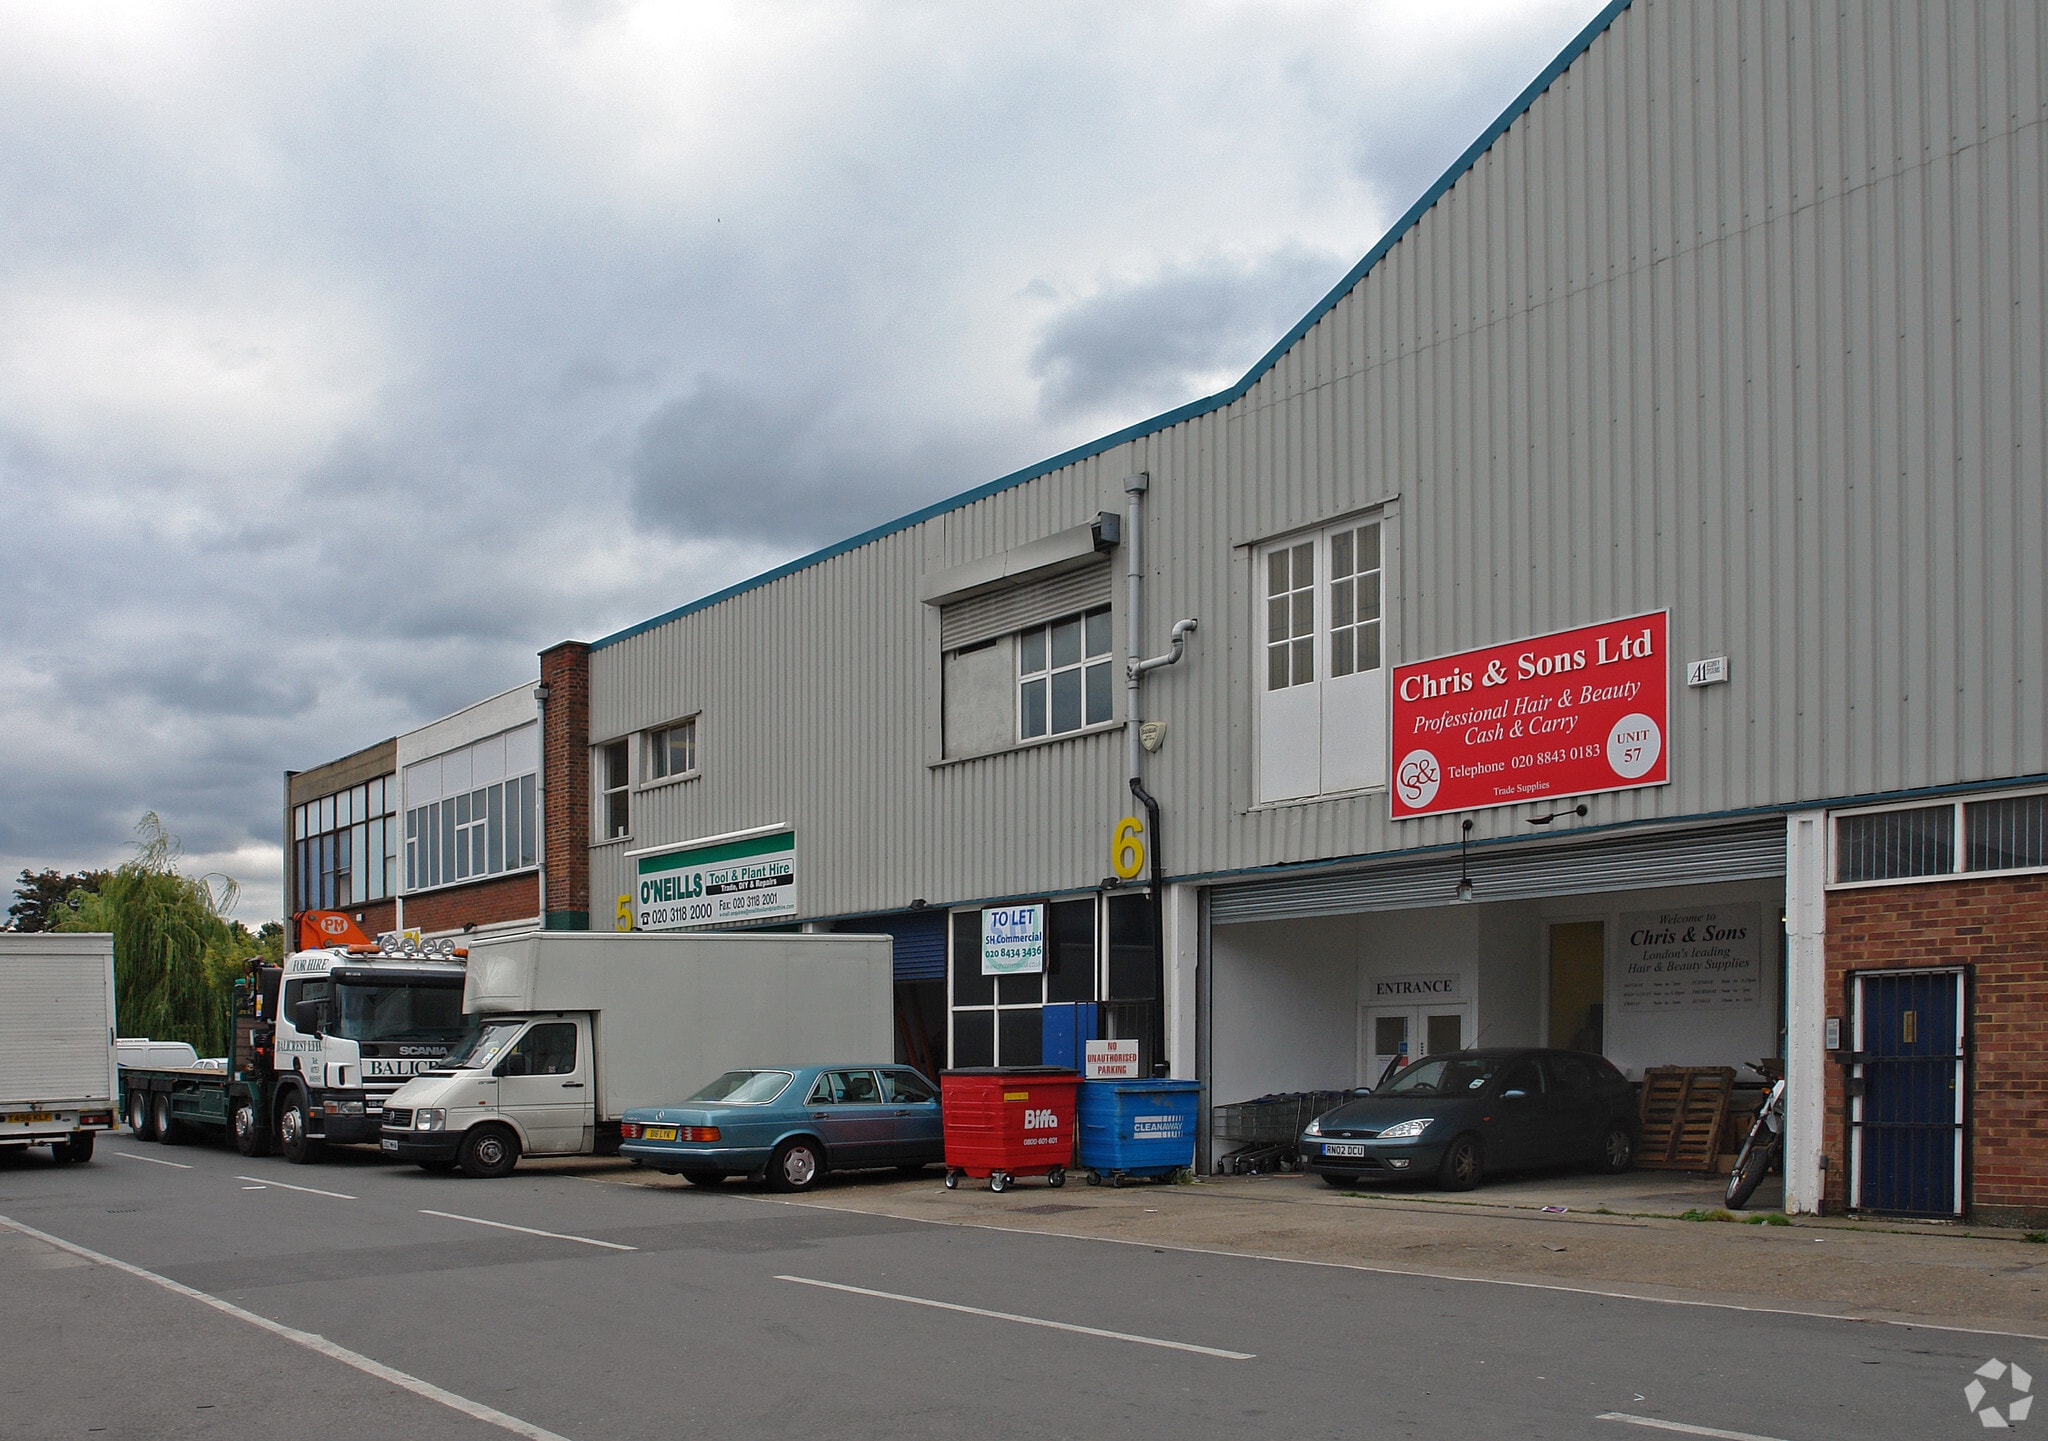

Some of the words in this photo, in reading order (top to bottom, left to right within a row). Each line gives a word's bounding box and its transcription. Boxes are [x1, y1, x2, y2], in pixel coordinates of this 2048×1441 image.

[1400, 668, 1473, 702] Chris
[1482, 660, 1508, 687] &
[1517, 647, 1586, 681] Sons
[1596, 629, 1653, 666] Ltd
[1413, 700, 1508, 734] Professional
[1514, 696, 1552, 716] Hair
[1557, 689, 1573, 707] &
[1578, 680, 1641, 704] Beauty
[1465, 724, 1504, 745] Cash
[1509, 719, 1524, 738] &
[1529, 715, 1578, 735] Carry
[1616, 729, 1650, 744] UNIT
[1448, 760, 1505, 779] Telephone
[1511, 755, 1533, 769] 020
[1537, 750, 1566, 765] 8843
[1570, 743, 1600, 760] 0183
[1624, 747, 1642, 763] 57
[1493, 786, 1516, 796] Trade
[1517, 781, 1550, 794] Supplies
[1112, 816, 1144, 879] 6
[641, 873, 702, 904] O'NEILLS
[709, 870, 728, 884] Tool
[732, 868, 739, 881] &
[742, 864, 766, 879] Plant
[769, 862, 790, 876] Hire
[721, 883, 739, 892] Trade,
[740, 881, 749, 891] DIY
[750, 880, 755, 889] &
[756, 877, 778, 888] Repairs
[719, 900, 731, 911] Fax:
[732, 897, 745, 909] 020
[747, 895, 760, 907] 3118
[762, 893, 778, 905] 2001
[615, 894, 633, 931] 5
[652, 909, 667, 924] 020
[670, 906, 687, 921] 3118
[690, 903, 712, 919] 2000
[991, 911, 1008, 927] TO
[1012, 909, 1035, 925] LET
[1660, 912, 1703, 924] Welcome
[1706, 913, 1716, 921] to
[325, 918, 346, 932] PM
[985, 935, 996, 945] SH
[996, 931, 1042, 944] Commercial
[1630, 929, 1676, 946] Chris
[1682, 926, 1697, 942] &
[1703, 925, 1747, 941] Sons
[985, 950, 999, 958] 020
[1000, 948, 1020, 958] 8434
[1022, 946, 1042, 958] 3436
[1643, 948, 1688, 960] London's
[1692, 946, 1730, 958] leading
[293, 960, 306, 971] FOR
[307, 959, 329, 970] HIRE
[1628, 963, 1651, 974] Hair
[1654, 961, 1662, 972] &
[1667, 960, 1703, 973] Beauty
[1705, 957, 1750, 971] Supplies
[1377, 980, 1452, 994] ENTRANCE
[399, 1046, 448, 1055] SCANIA
[1108, 1042, 1117, 1050] NO
[1088, 1053, 1137, 1063] UNAUTHORISED
[1098, 1065, 1127, 1075] PARKING
[1024, 1109, 1057, 1129] Biffa
[1134, 1122, 1182, 1131] CLEANAWAY
[1327, 1145, 1346, 1155] RN02
[1347, 1146, 1363, 1155] DCU
